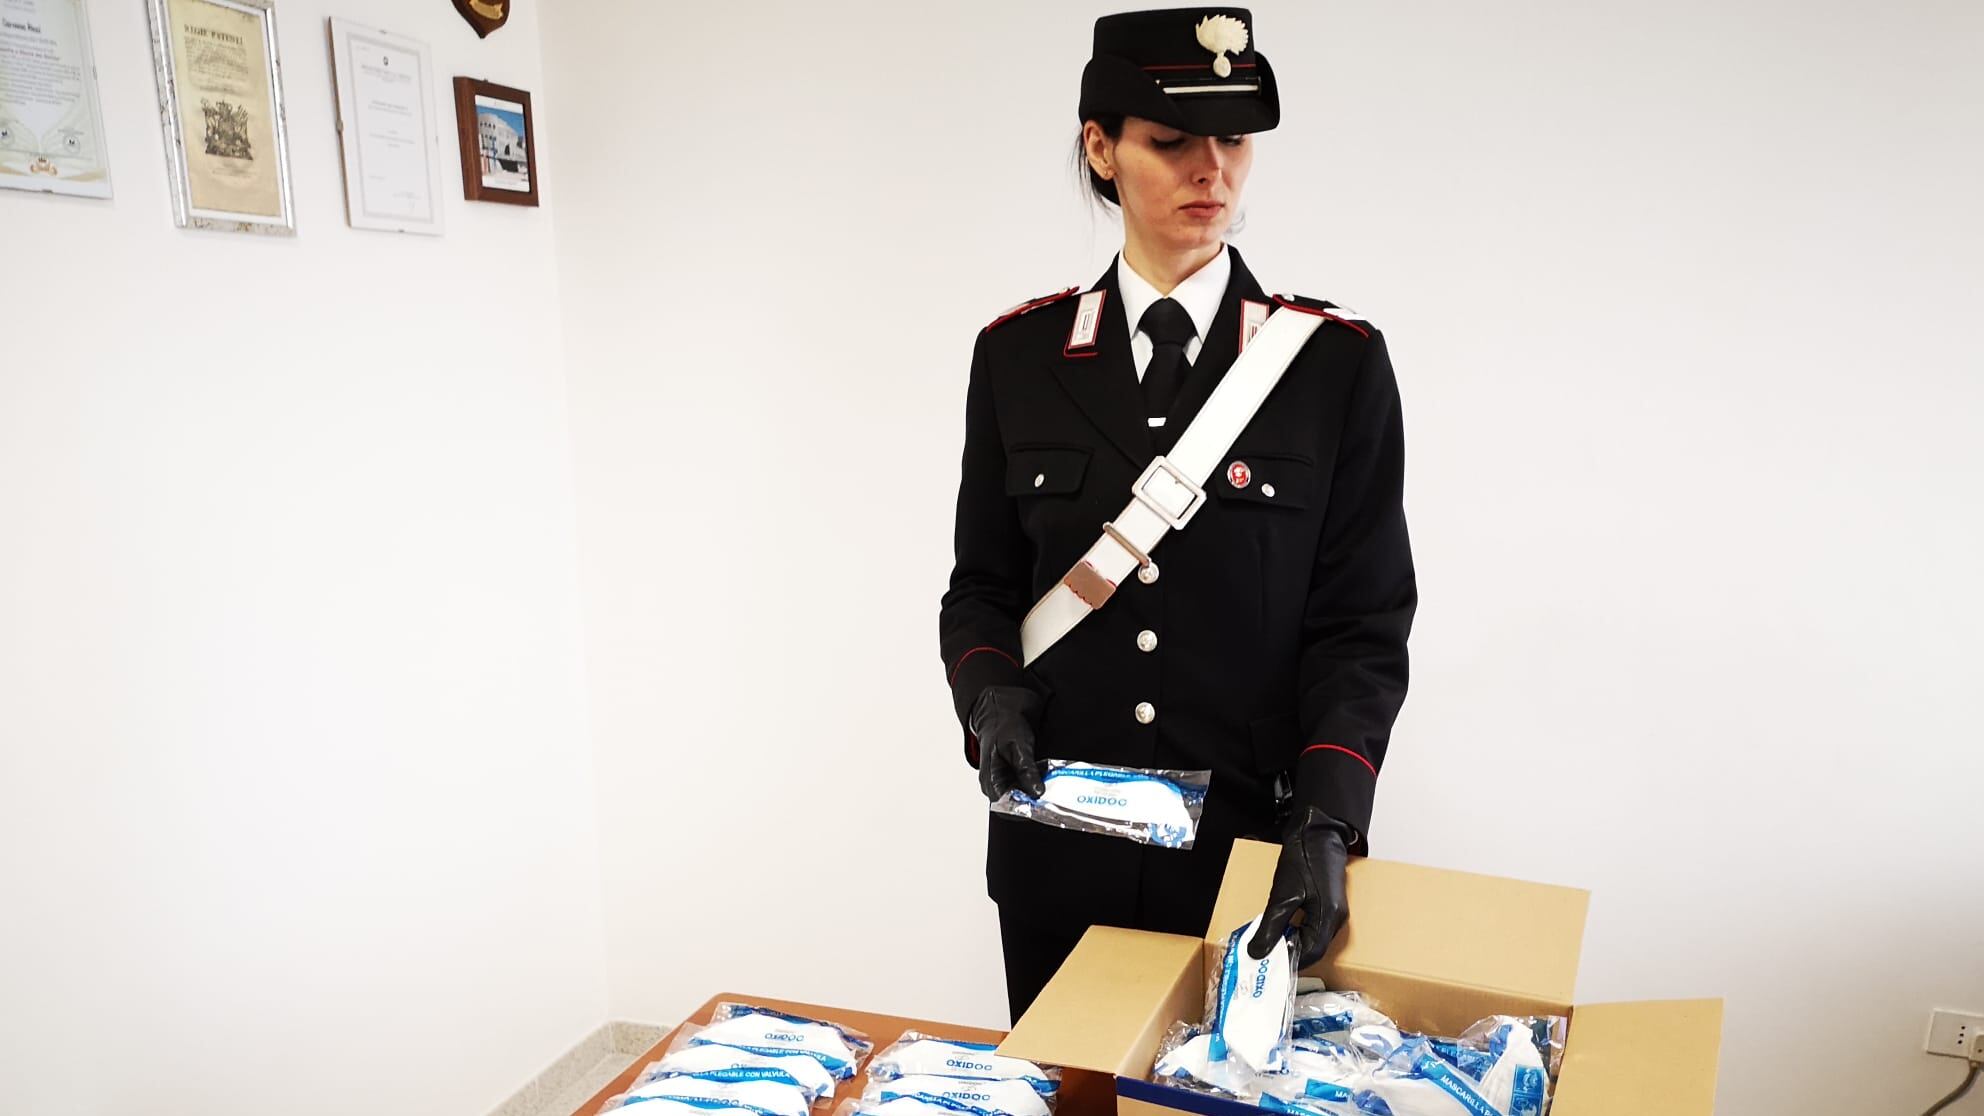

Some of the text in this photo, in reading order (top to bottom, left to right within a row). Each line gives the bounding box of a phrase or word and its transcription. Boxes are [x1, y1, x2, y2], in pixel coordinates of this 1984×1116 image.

[1077, 795, 1127, 807] OXIDOC
[1253, 959, 1269, 998] OXIDOC
[946, 1059, 993, 1071] OXIDOC
[943, 1091, 991, 1101] OXIDOC
[1440, 1074, 1484, 1114] MASCARILLA
